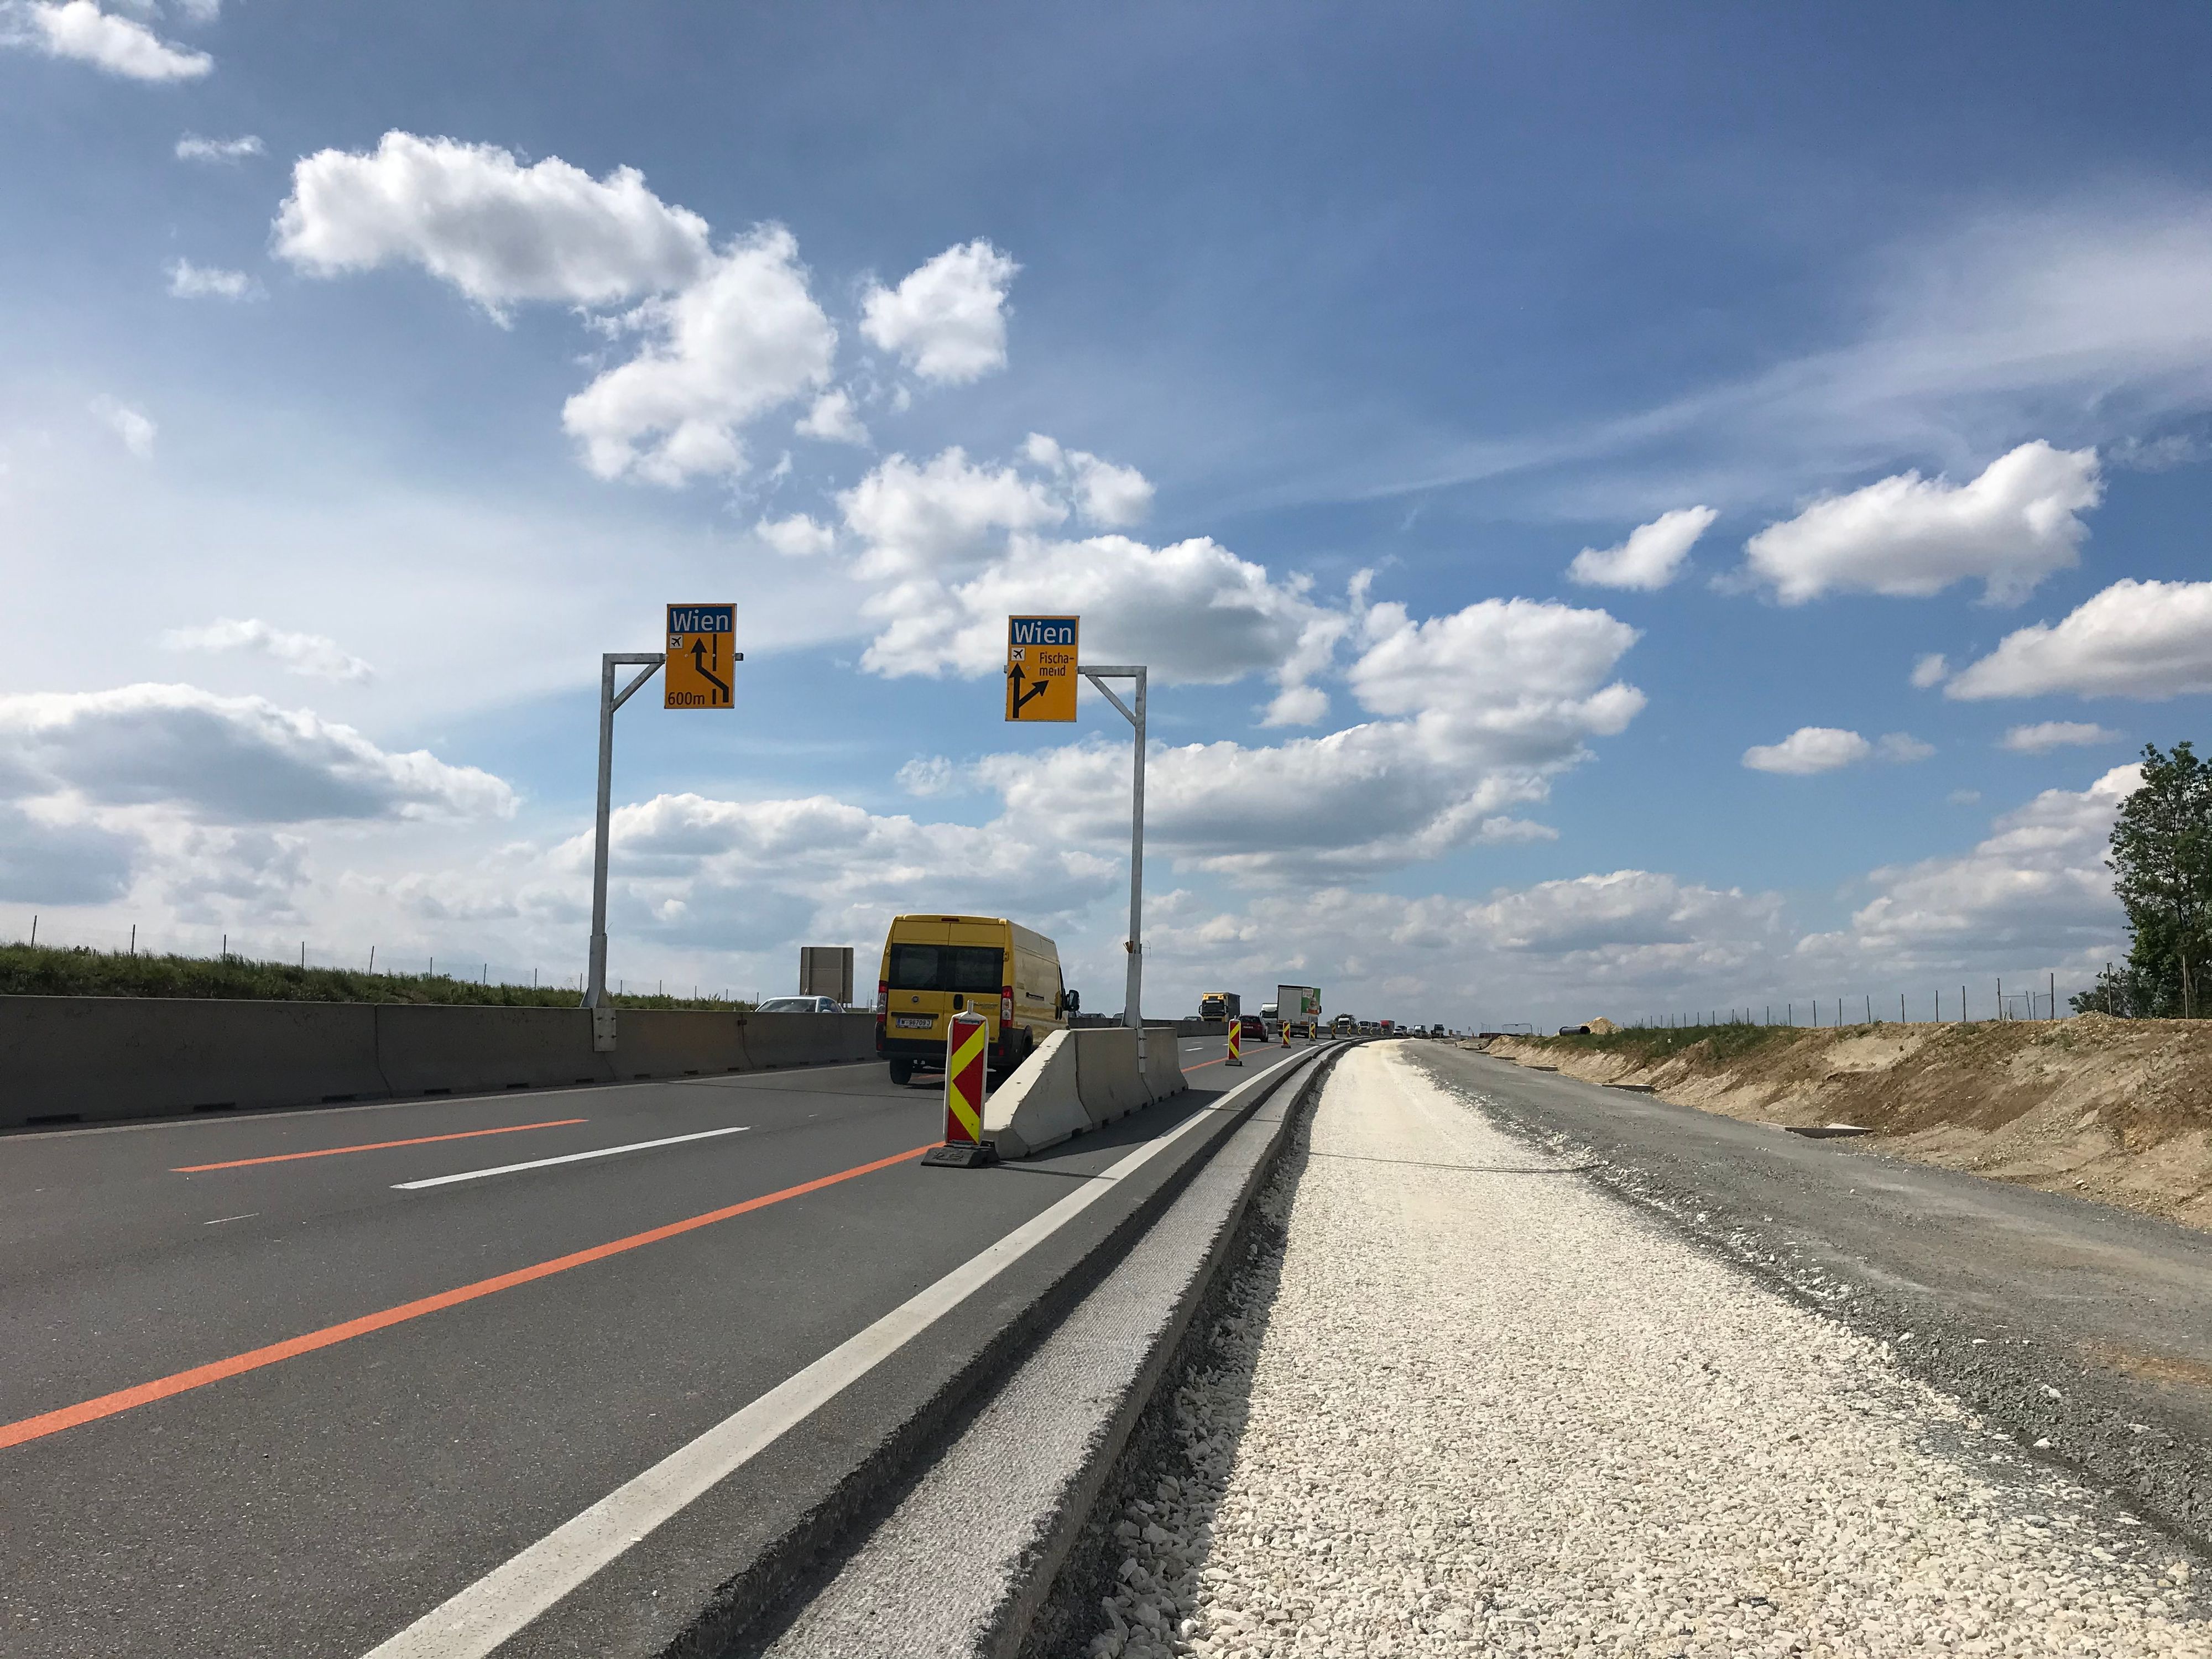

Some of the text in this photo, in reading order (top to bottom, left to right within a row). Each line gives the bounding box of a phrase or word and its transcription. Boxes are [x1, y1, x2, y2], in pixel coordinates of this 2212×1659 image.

[672, 609, 729, 632] Wien
[1014, 621, 1071, 644] Wien
[1040, 652, 1074, 664] Fischa-
[1040, 665, 1066, 676] mend
[668, 692, 705, 705] 600m
